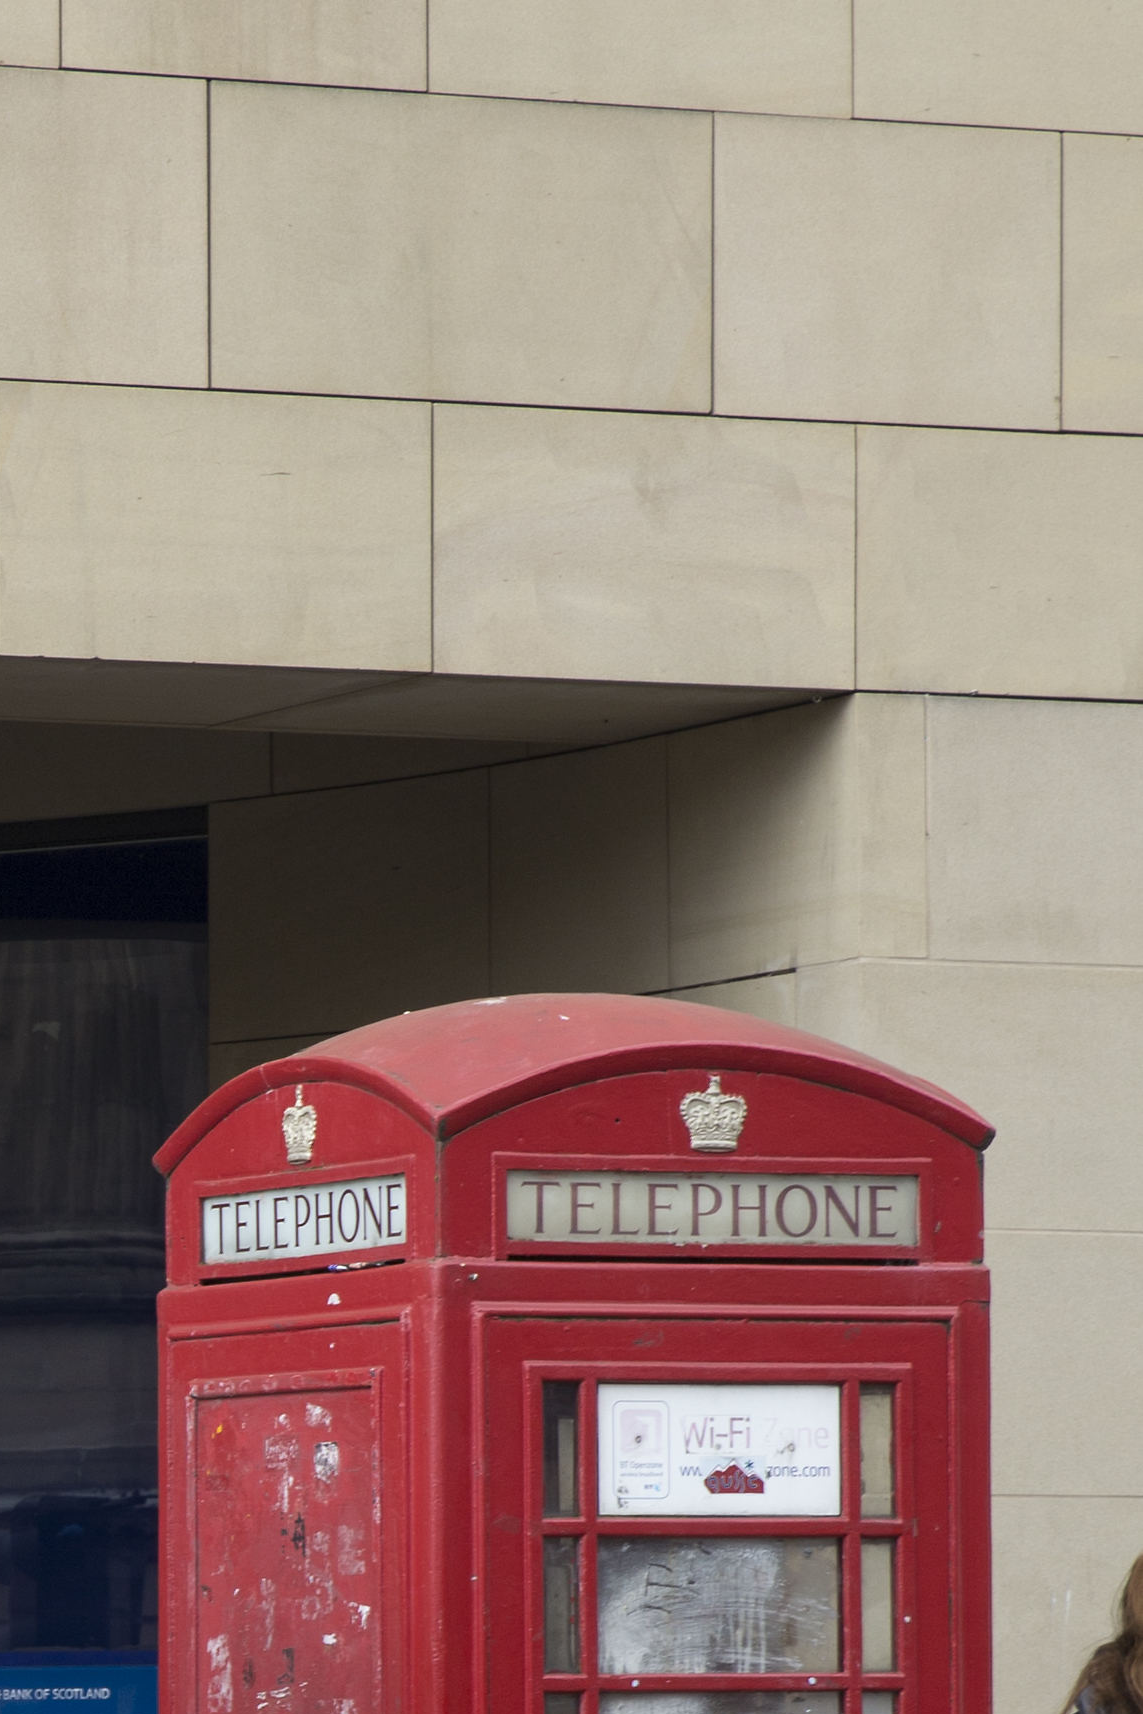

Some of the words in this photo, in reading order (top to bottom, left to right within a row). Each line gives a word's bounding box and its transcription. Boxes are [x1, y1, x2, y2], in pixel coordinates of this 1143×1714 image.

[211, 1184, 402, 1255] TELEPHONE
[521, 1180, 898, 1238] TELEPHONE
[680, 1416, 750, 1449] Wi-Fi
[3, 1688, 33, 1701] BANK
[34, 1688, 51, 1700] OF
[52, 1687, 111, 1700] SCOTLAND
